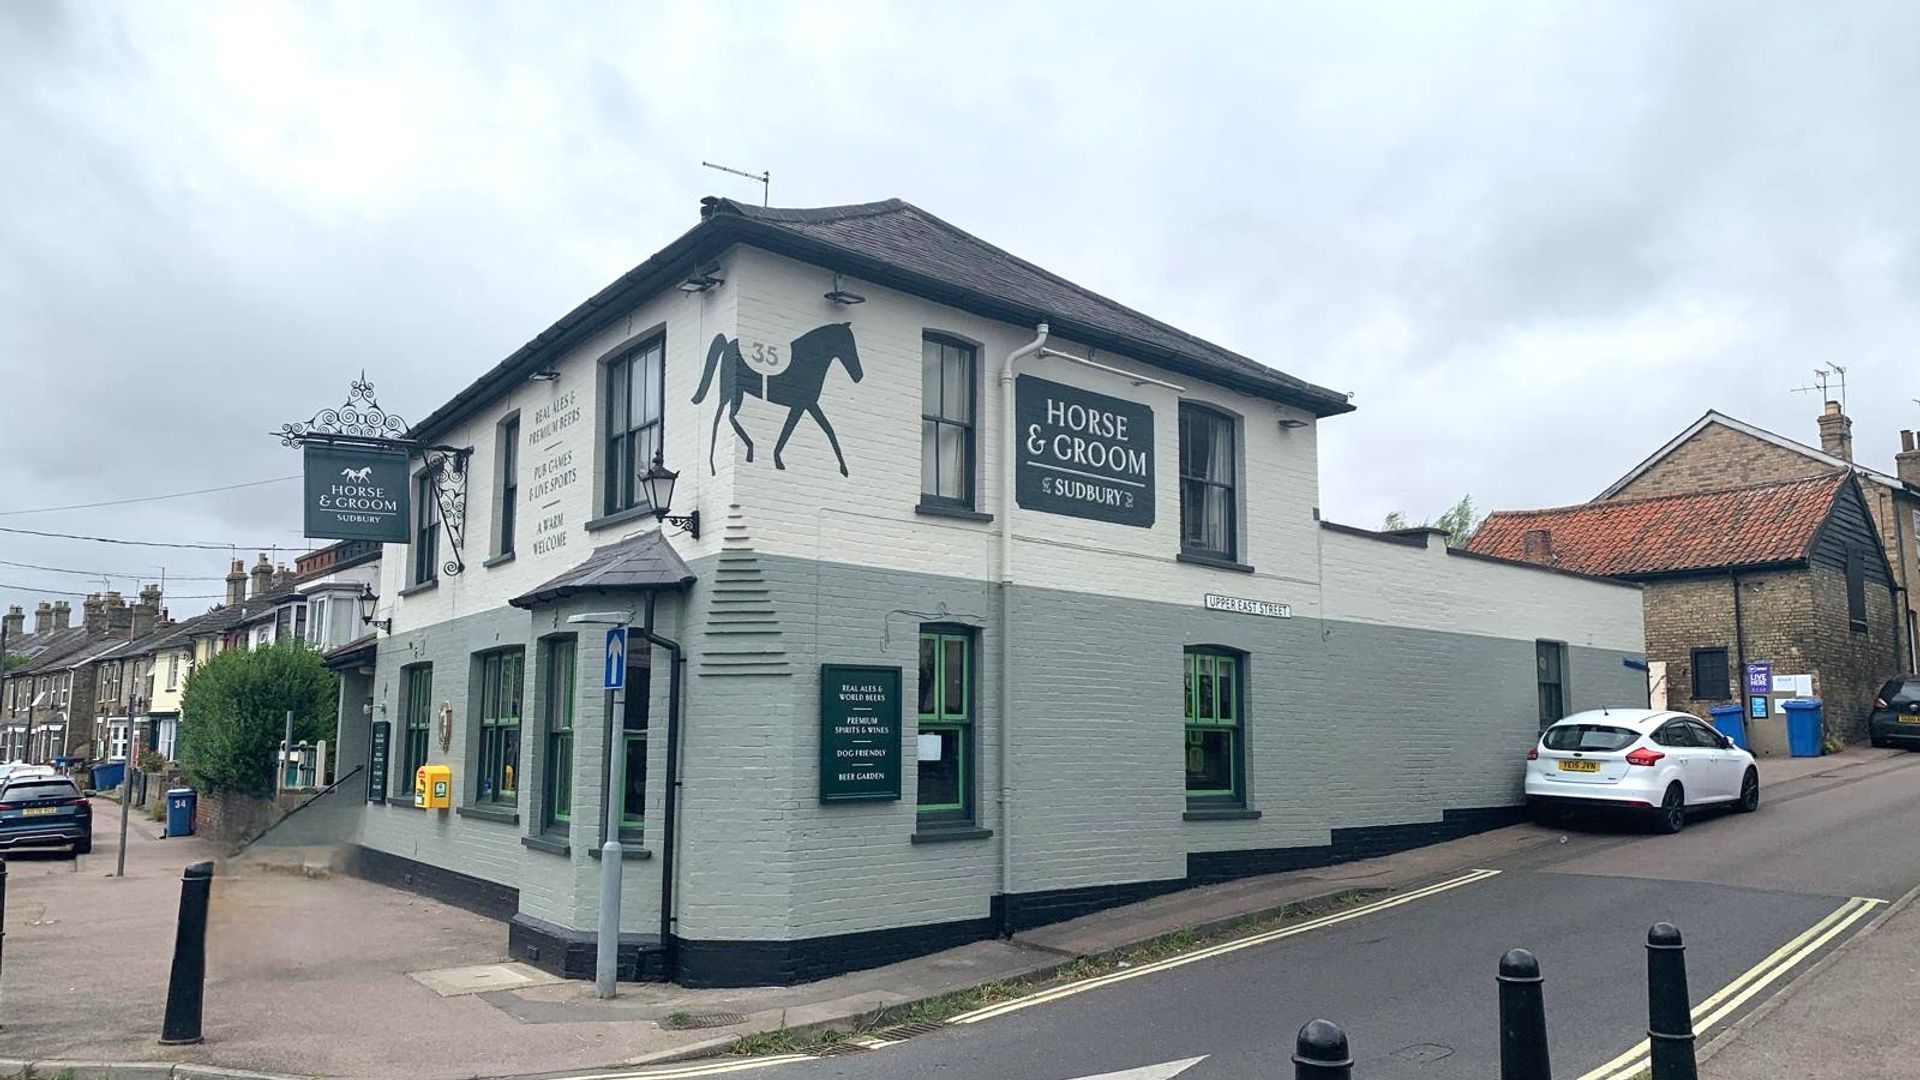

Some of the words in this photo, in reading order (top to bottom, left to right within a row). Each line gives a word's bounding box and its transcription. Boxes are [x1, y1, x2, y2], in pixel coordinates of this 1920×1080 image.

[751, 341, 779, 366] 35
[1047, 399, 1129, 441] HORSE
[1027, 424, 1047, 454] &
[1053, 434, 1146, 476] GROOM
[331, 485, 385, 498] HORSE
[1055, 478, 1123, 506] SUDBURY
[319, 494, 332, 507] &
[335, 497, 397, 511] GROOM
[336, 514, 382, 523] SUDBURY
[533, 530, 567, 555] WELCOME
[1209, 597, 1236, 610] UPPER
[1238, 600, 1258, 612] EAST
[1260, 603, 1288, 616] STREET
[1750, 673, 1767, 681] LIVE
[842, 684, 858, 692] REAL
[839, 693, 864, 701] WORLD
[865, 694, 886, 702] BEERS
[847, 716, 878, 725] PREMIUM
[835, 726, 860, 734] SPIRITS
[867, 726, 889, 734] WINES
[837, 749, 855, 757] DOG
[855, 749, 886, 757] FRIENDLY
[838, 773, 856, 781] BEER
[856, 772, 885, 780] GARDEN
[175, 799, 187, 809] 34
